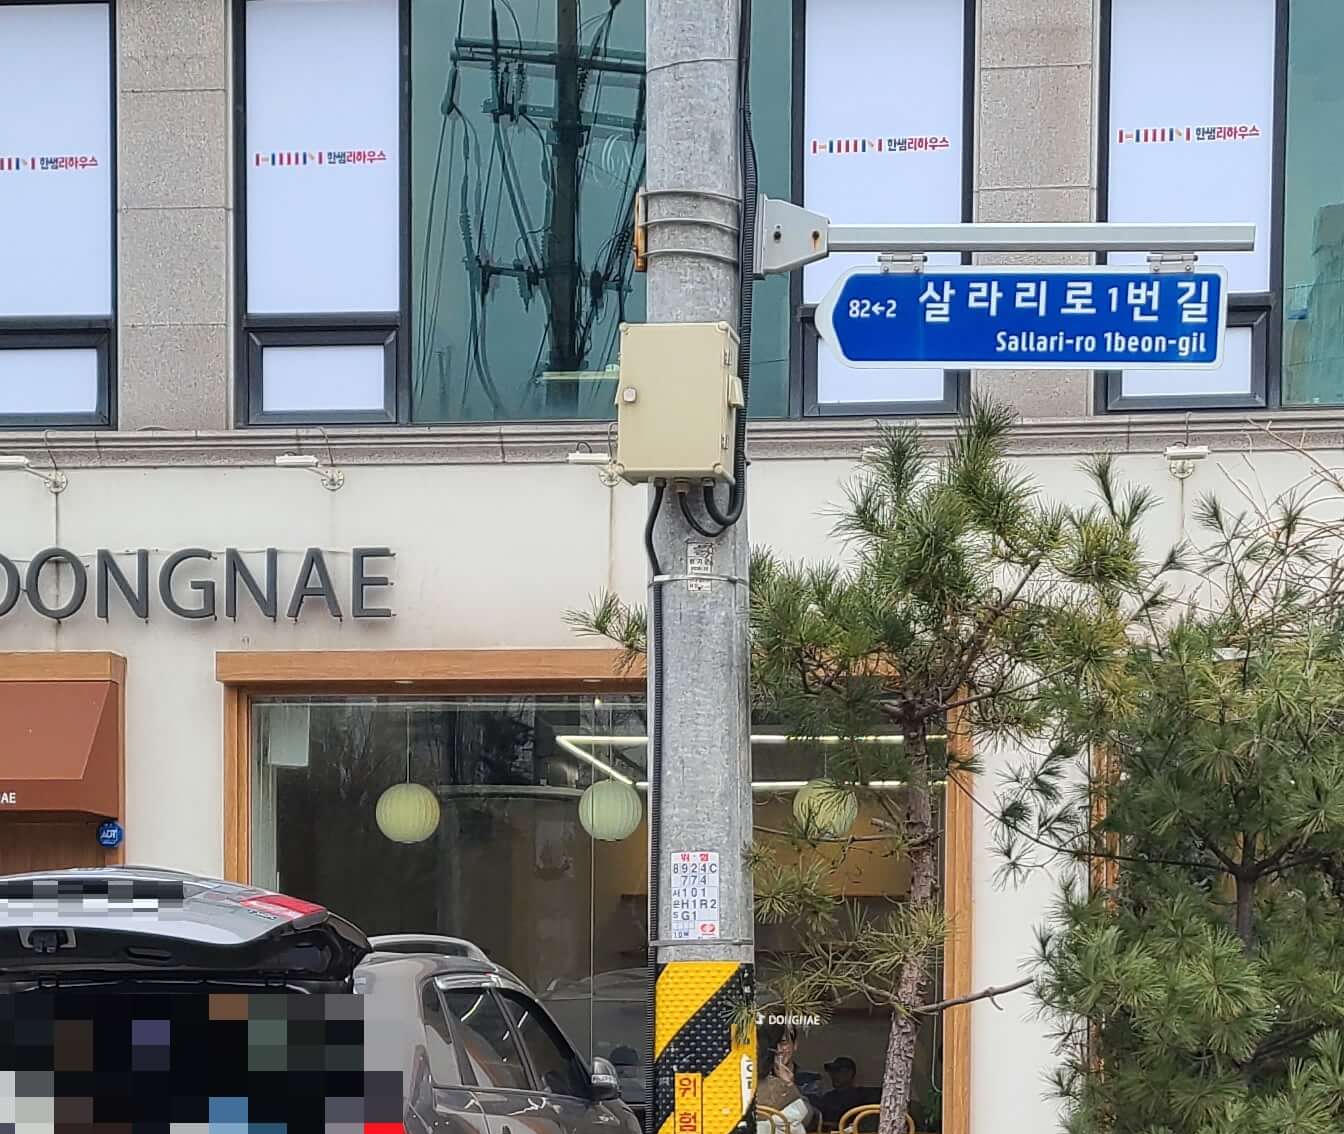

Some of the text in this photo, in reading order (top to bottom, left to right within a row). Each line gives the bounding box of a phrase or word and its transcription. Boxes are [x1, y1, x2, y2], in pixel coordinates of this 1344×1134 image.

[996, 331, 1206, 357] Sallari-ro 1beon-gil
[673, 863, 717, 874] 8924C
[681, 875, 707, 885] 774
